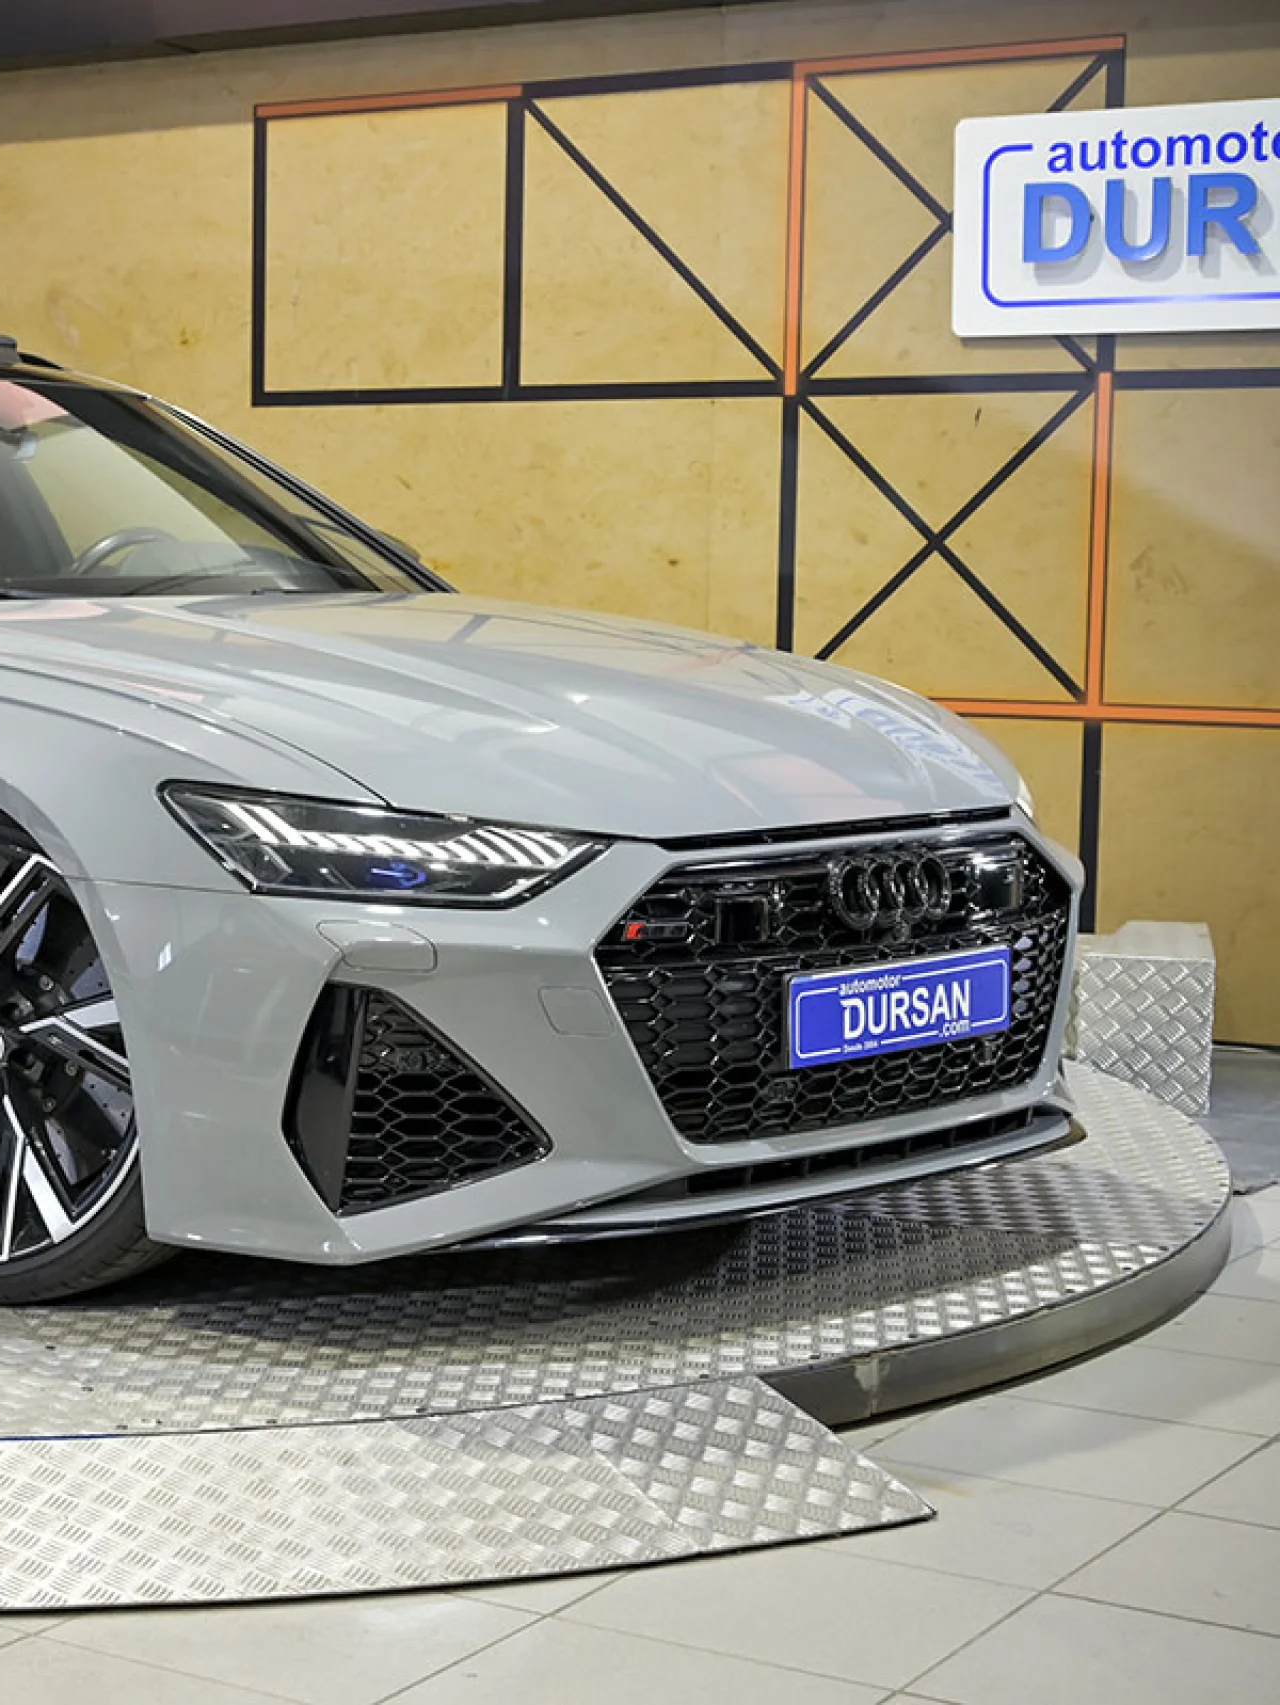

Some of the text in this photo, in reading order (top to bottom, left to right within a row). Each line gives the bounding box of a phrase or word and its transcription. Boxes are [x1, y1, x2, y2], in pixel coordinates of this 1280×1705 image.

[1047, 121, 1280, 173] automot
[1023, 173, 1262, 263] DUR
[839, 975, 901, 997] automotor
[840, 979, 971, 1040] DURSAN
[939, 1019, 971, 1037] .com
